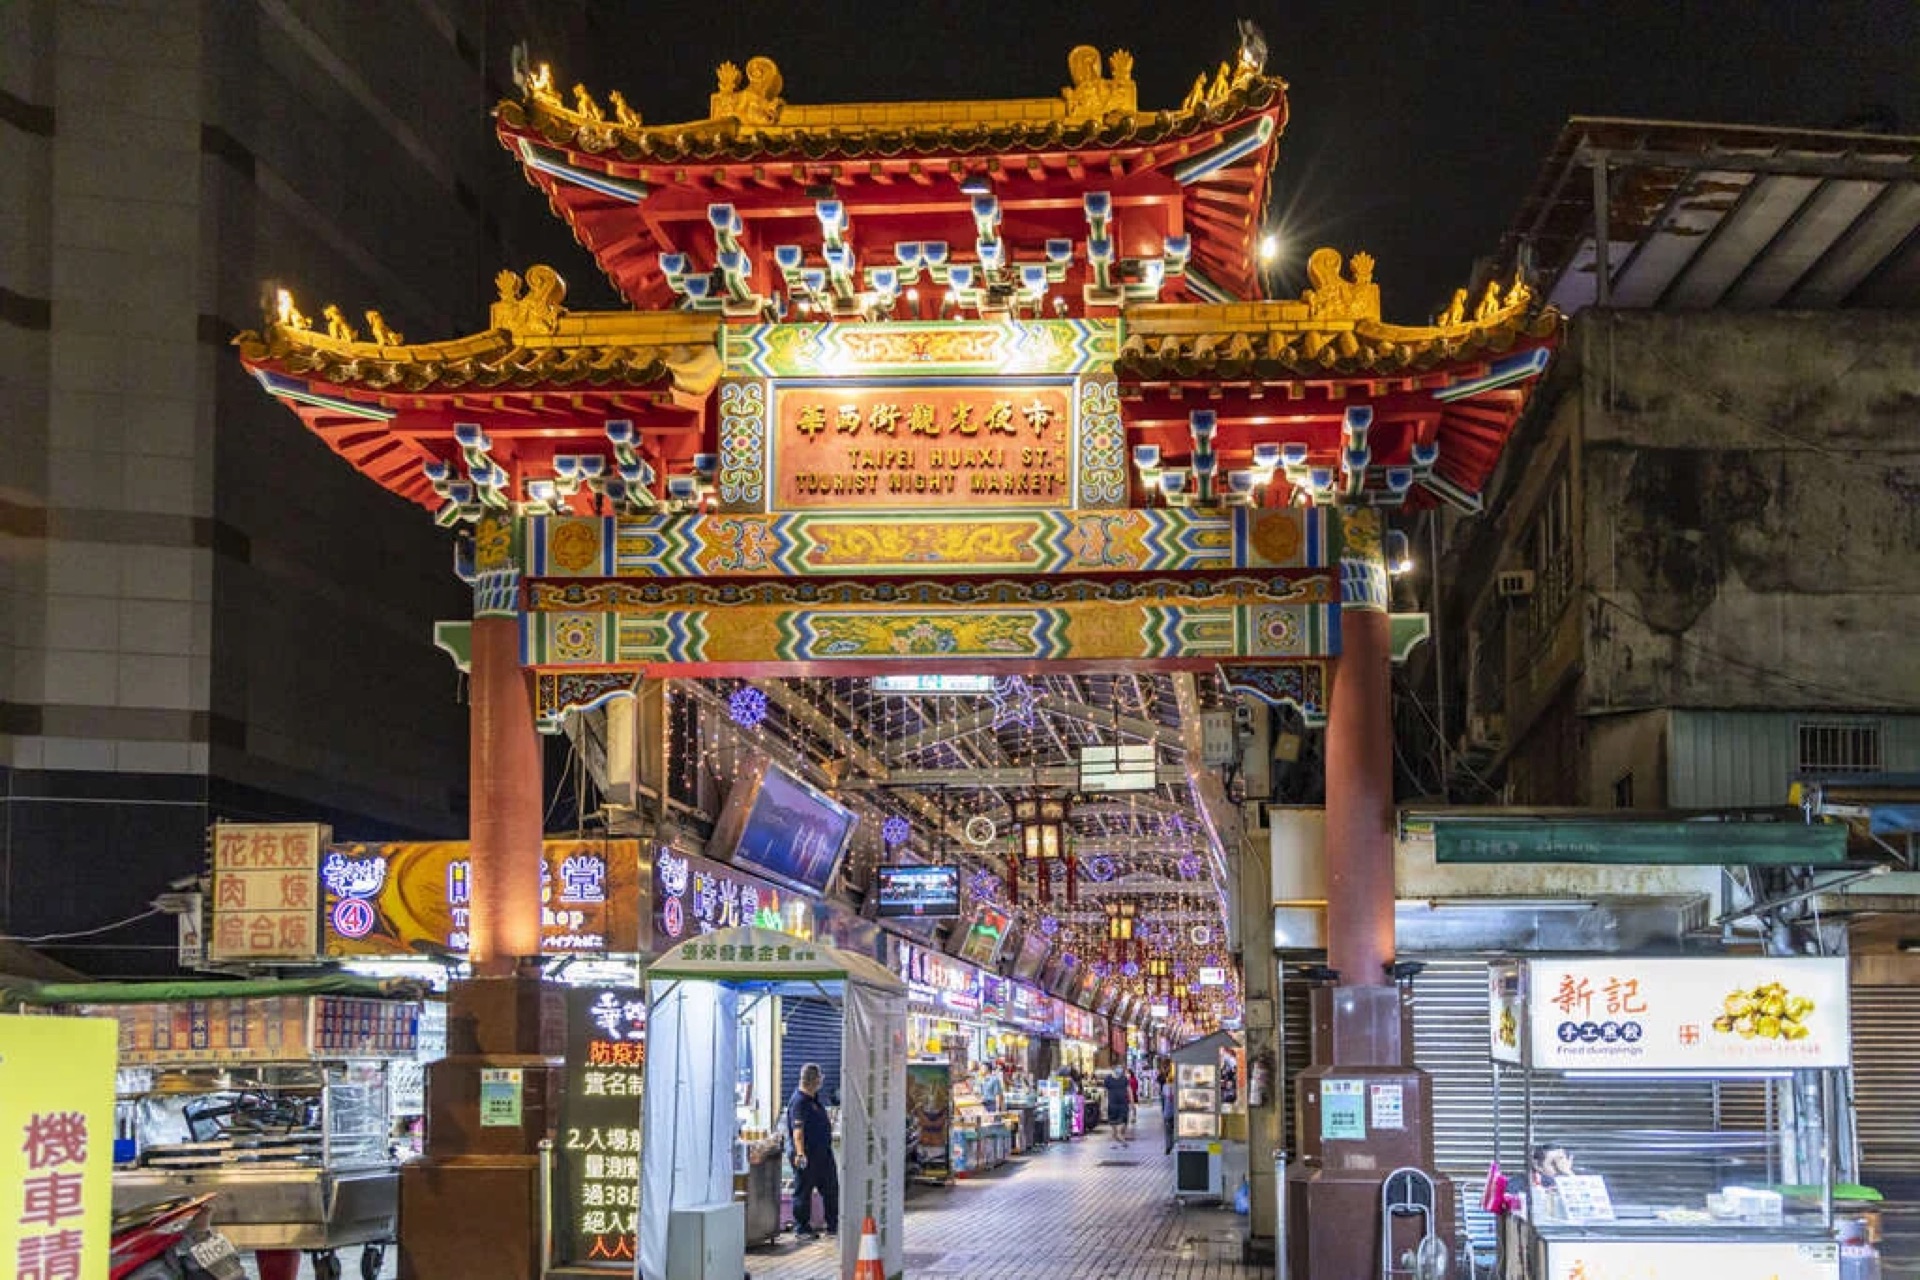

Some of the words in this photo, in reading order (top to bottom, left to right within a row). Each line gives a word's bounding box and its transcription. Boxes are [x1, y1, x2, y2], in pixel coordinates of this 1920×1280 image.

[848, 447, 915, 470] TAIPEI
[929, 447, 1005, 470] HUAXI
[1020, 446, 1053, 469] ST.
[795, 473, 879, 496] TOURIST
[888, 473, 956, 496] NIGHT
[970, 472, 1056, 496] MARKET
[542, 907, 585, 931] hop
[1550, 974, 1648, 1019] 新記
